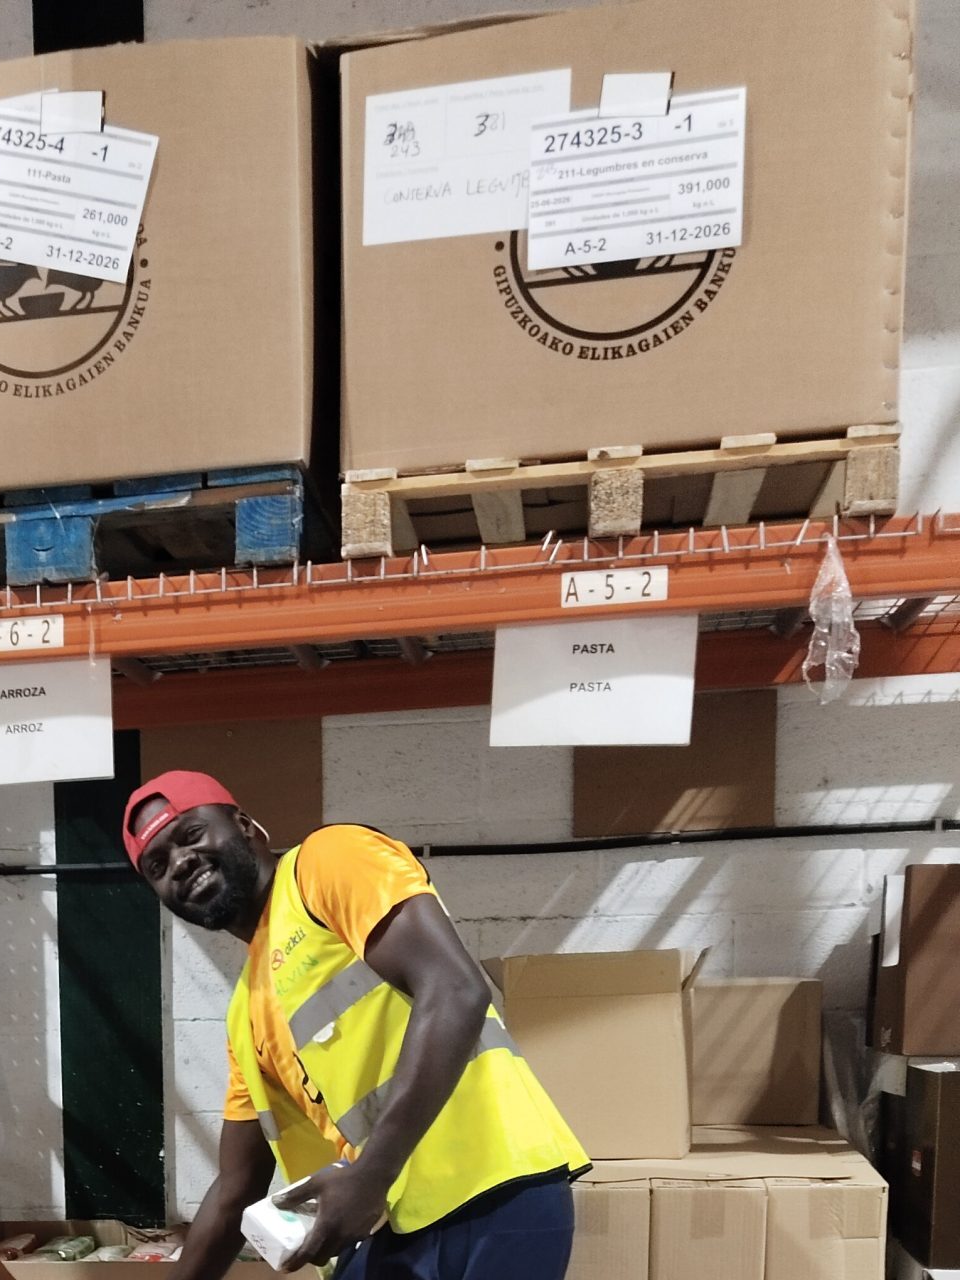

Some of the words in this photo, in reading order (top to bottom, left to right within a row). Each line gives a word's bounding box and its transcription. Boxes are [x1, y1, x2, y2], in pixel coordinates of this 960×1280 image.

[544, 122, 643, 153] 274325-3
[558, 159, 638, 180] 211-Legumbres
[642, 160, 655, 169] en
[658, 151, 708, 167] conserva
[27, 168, 71, 184] 111-Pasta
[678, 177, 730, 196] 391,000
[83, 208, 128, 226] 261,000
[646, 222, 731, 246] 31-12-2026
[564, 238, 606, 256] A-5-2
[46, 246, 120, 270] 31-12-2026
[493, 265, 574, 356] GIPUZKOAKO
[577, 311, 695, 361] ELIKAGAIEN
[693, 248, 737, 313] BANKU
[12, 354, 116, 398] ELIKAGAIEN
[119, 279, 152, 353] BANKUA
[572, 643, 616, 656] PASTA
[0, 686, 47, 701] ARROZA
[569, 682, 613, 694] PASTA
[4, 723, 44, 736] ARROZ
